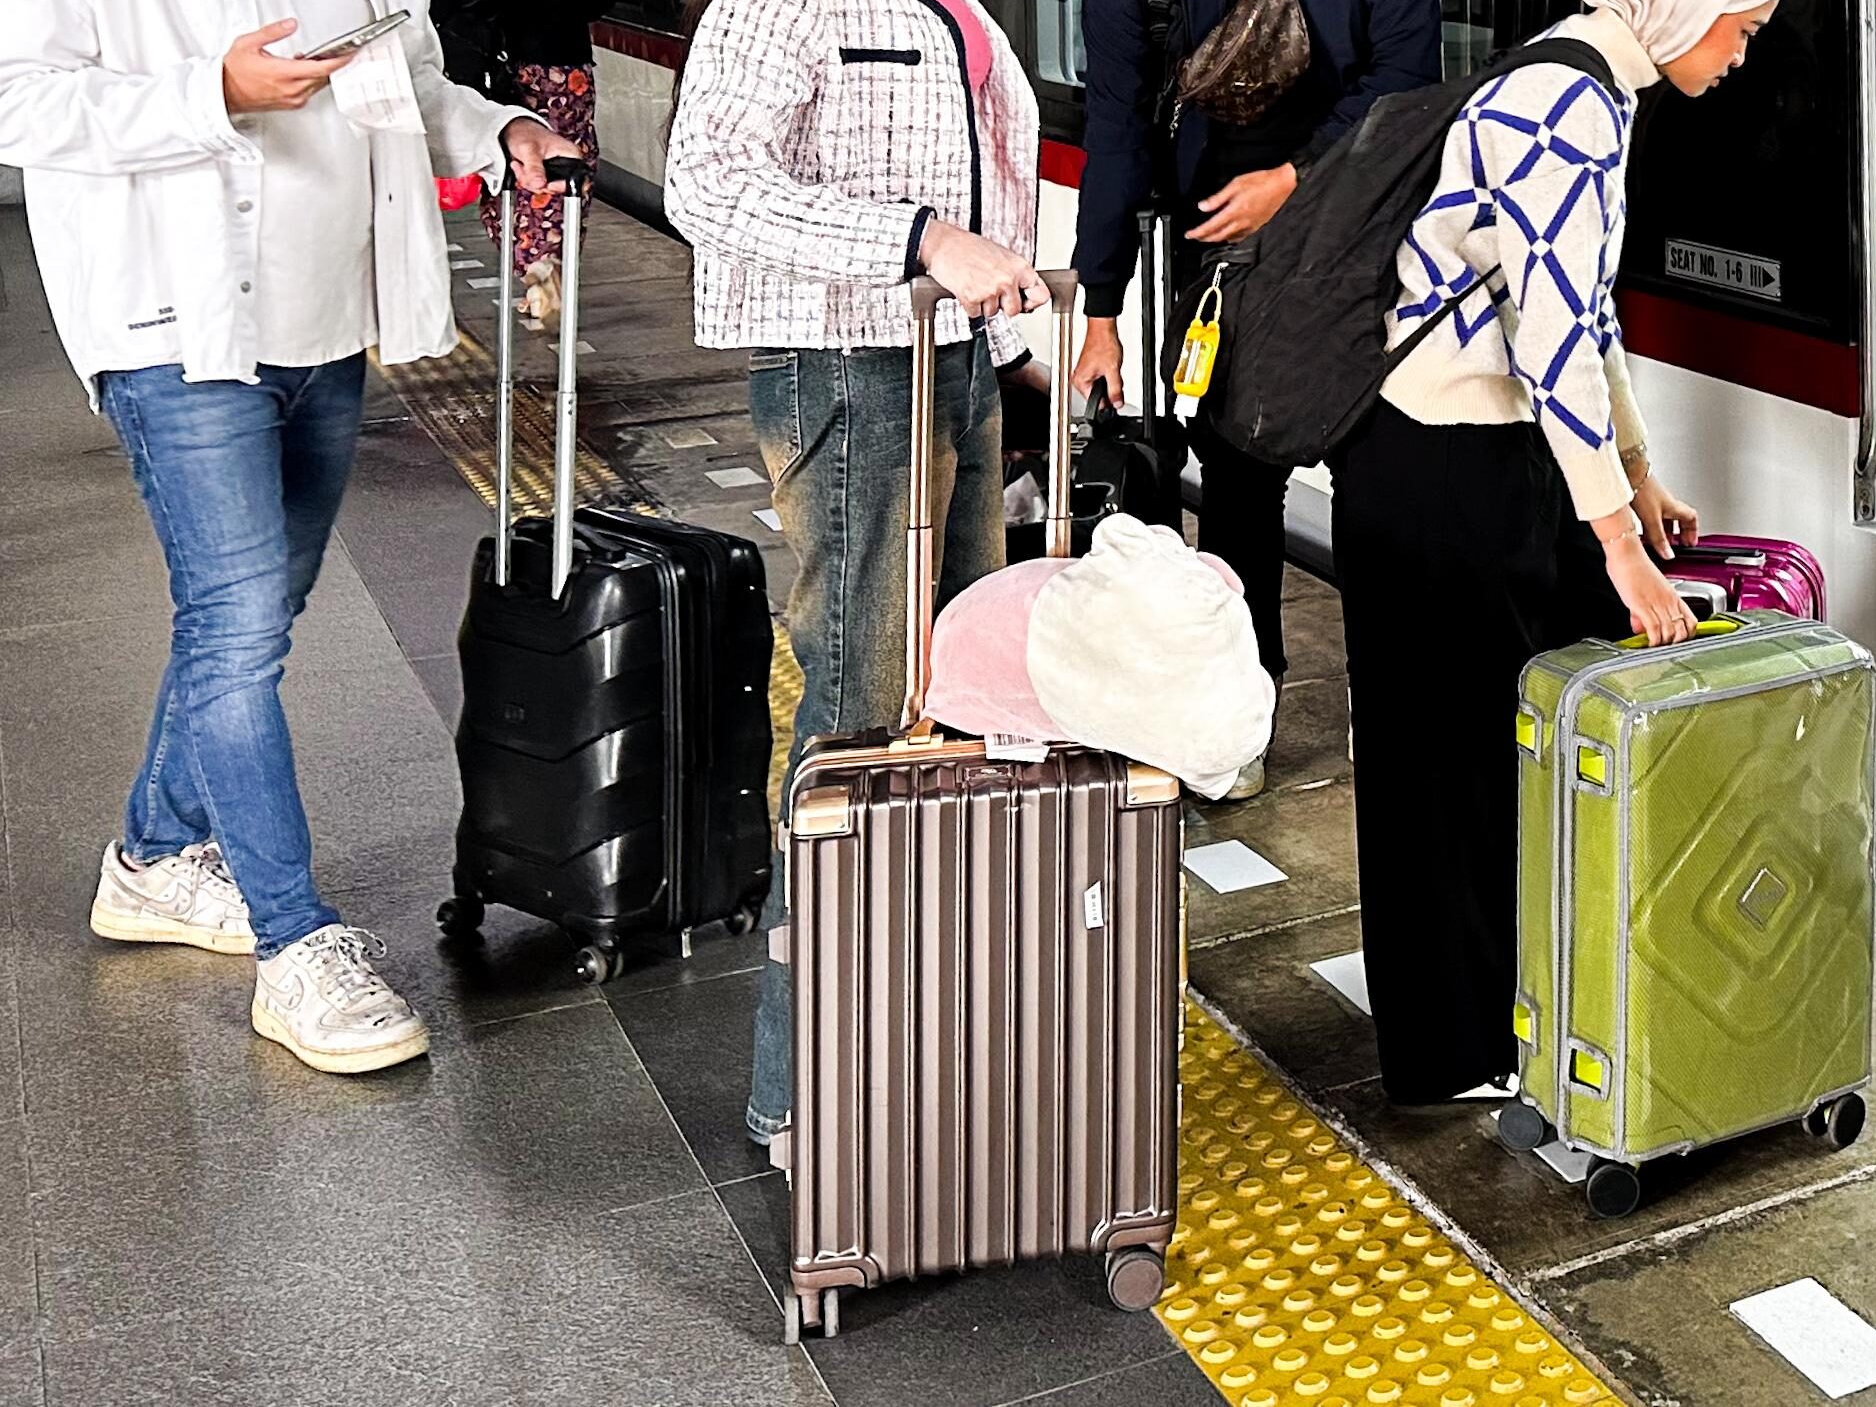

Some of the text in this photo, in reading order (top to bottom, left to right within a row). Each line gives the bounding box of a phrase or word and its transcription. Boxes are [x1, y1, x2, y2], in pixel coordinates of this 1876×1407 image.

[1670, 246, 1743, 283] SEAT NO. 1-6
